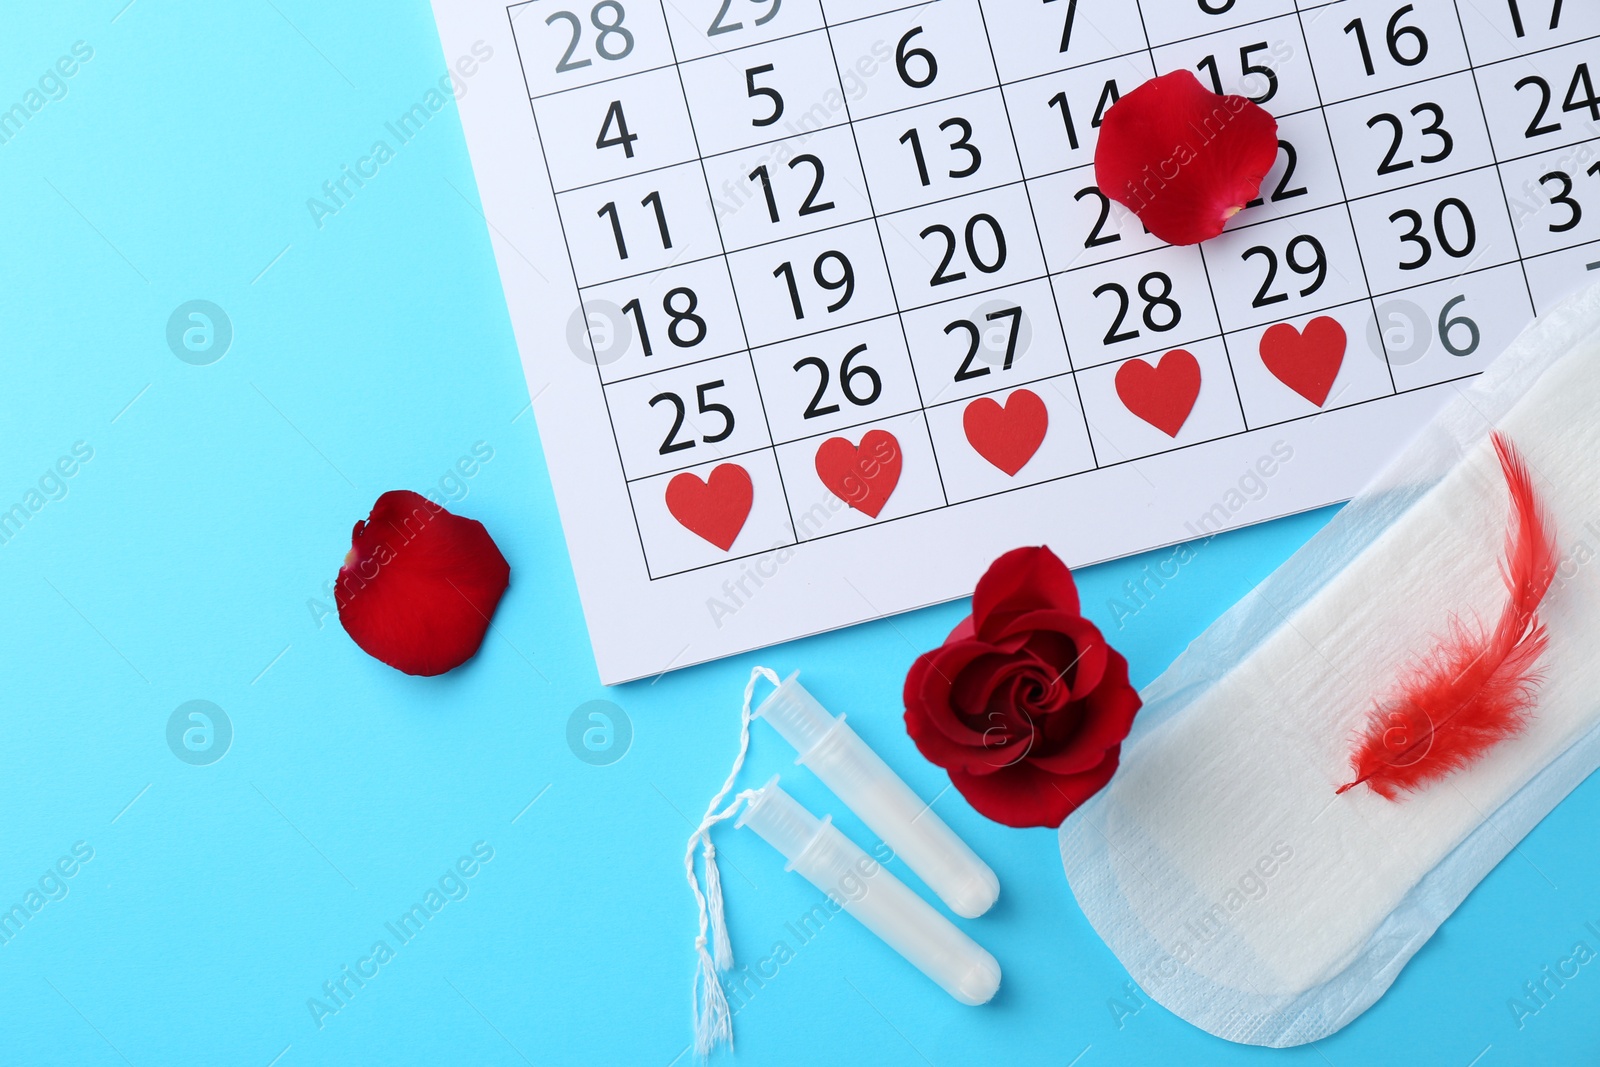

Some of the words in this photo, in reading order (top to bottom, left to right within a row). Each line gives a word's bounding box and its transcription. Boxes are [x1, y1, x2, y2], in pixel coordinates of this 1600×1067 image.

[546, 0, 633, 73] 28
[596, 101, 638, 158] 4
[746, 63, 784, 126] 5
[896, 26, 937, 88] 6
[1043, 0, 1078, 53] 7
[597, 191, 672, 260] 11
[749, 154, 835, 223] 12
[899, 117, 981, 186] 13
[1197, 41, 1279, 104] 15
[1344, 4, 1428, 76] 16
[622, 287, 707, 357] 18
[773, 250, 854, 320] 19
[919, 213, 1006, 287] 20
[1074, 186, 1150, 249] 2
[1246, 139, 1307, 209] 2
[1366, 102, 1453, 176] 23
[1514, 63, 1600, 138] 24
[649, 380, 735, 455] 25
[793, 343, 882, 419] 26
[944, 306, 1023, 382] 27
[1093, 272, 1181, 345] 28
[1241, 235, 1327, 308] 29
[1389, 198, 1476, 270] 30
[1539, 161, 1600, 232] 3
[1438, 295, 1480, 356] 6
